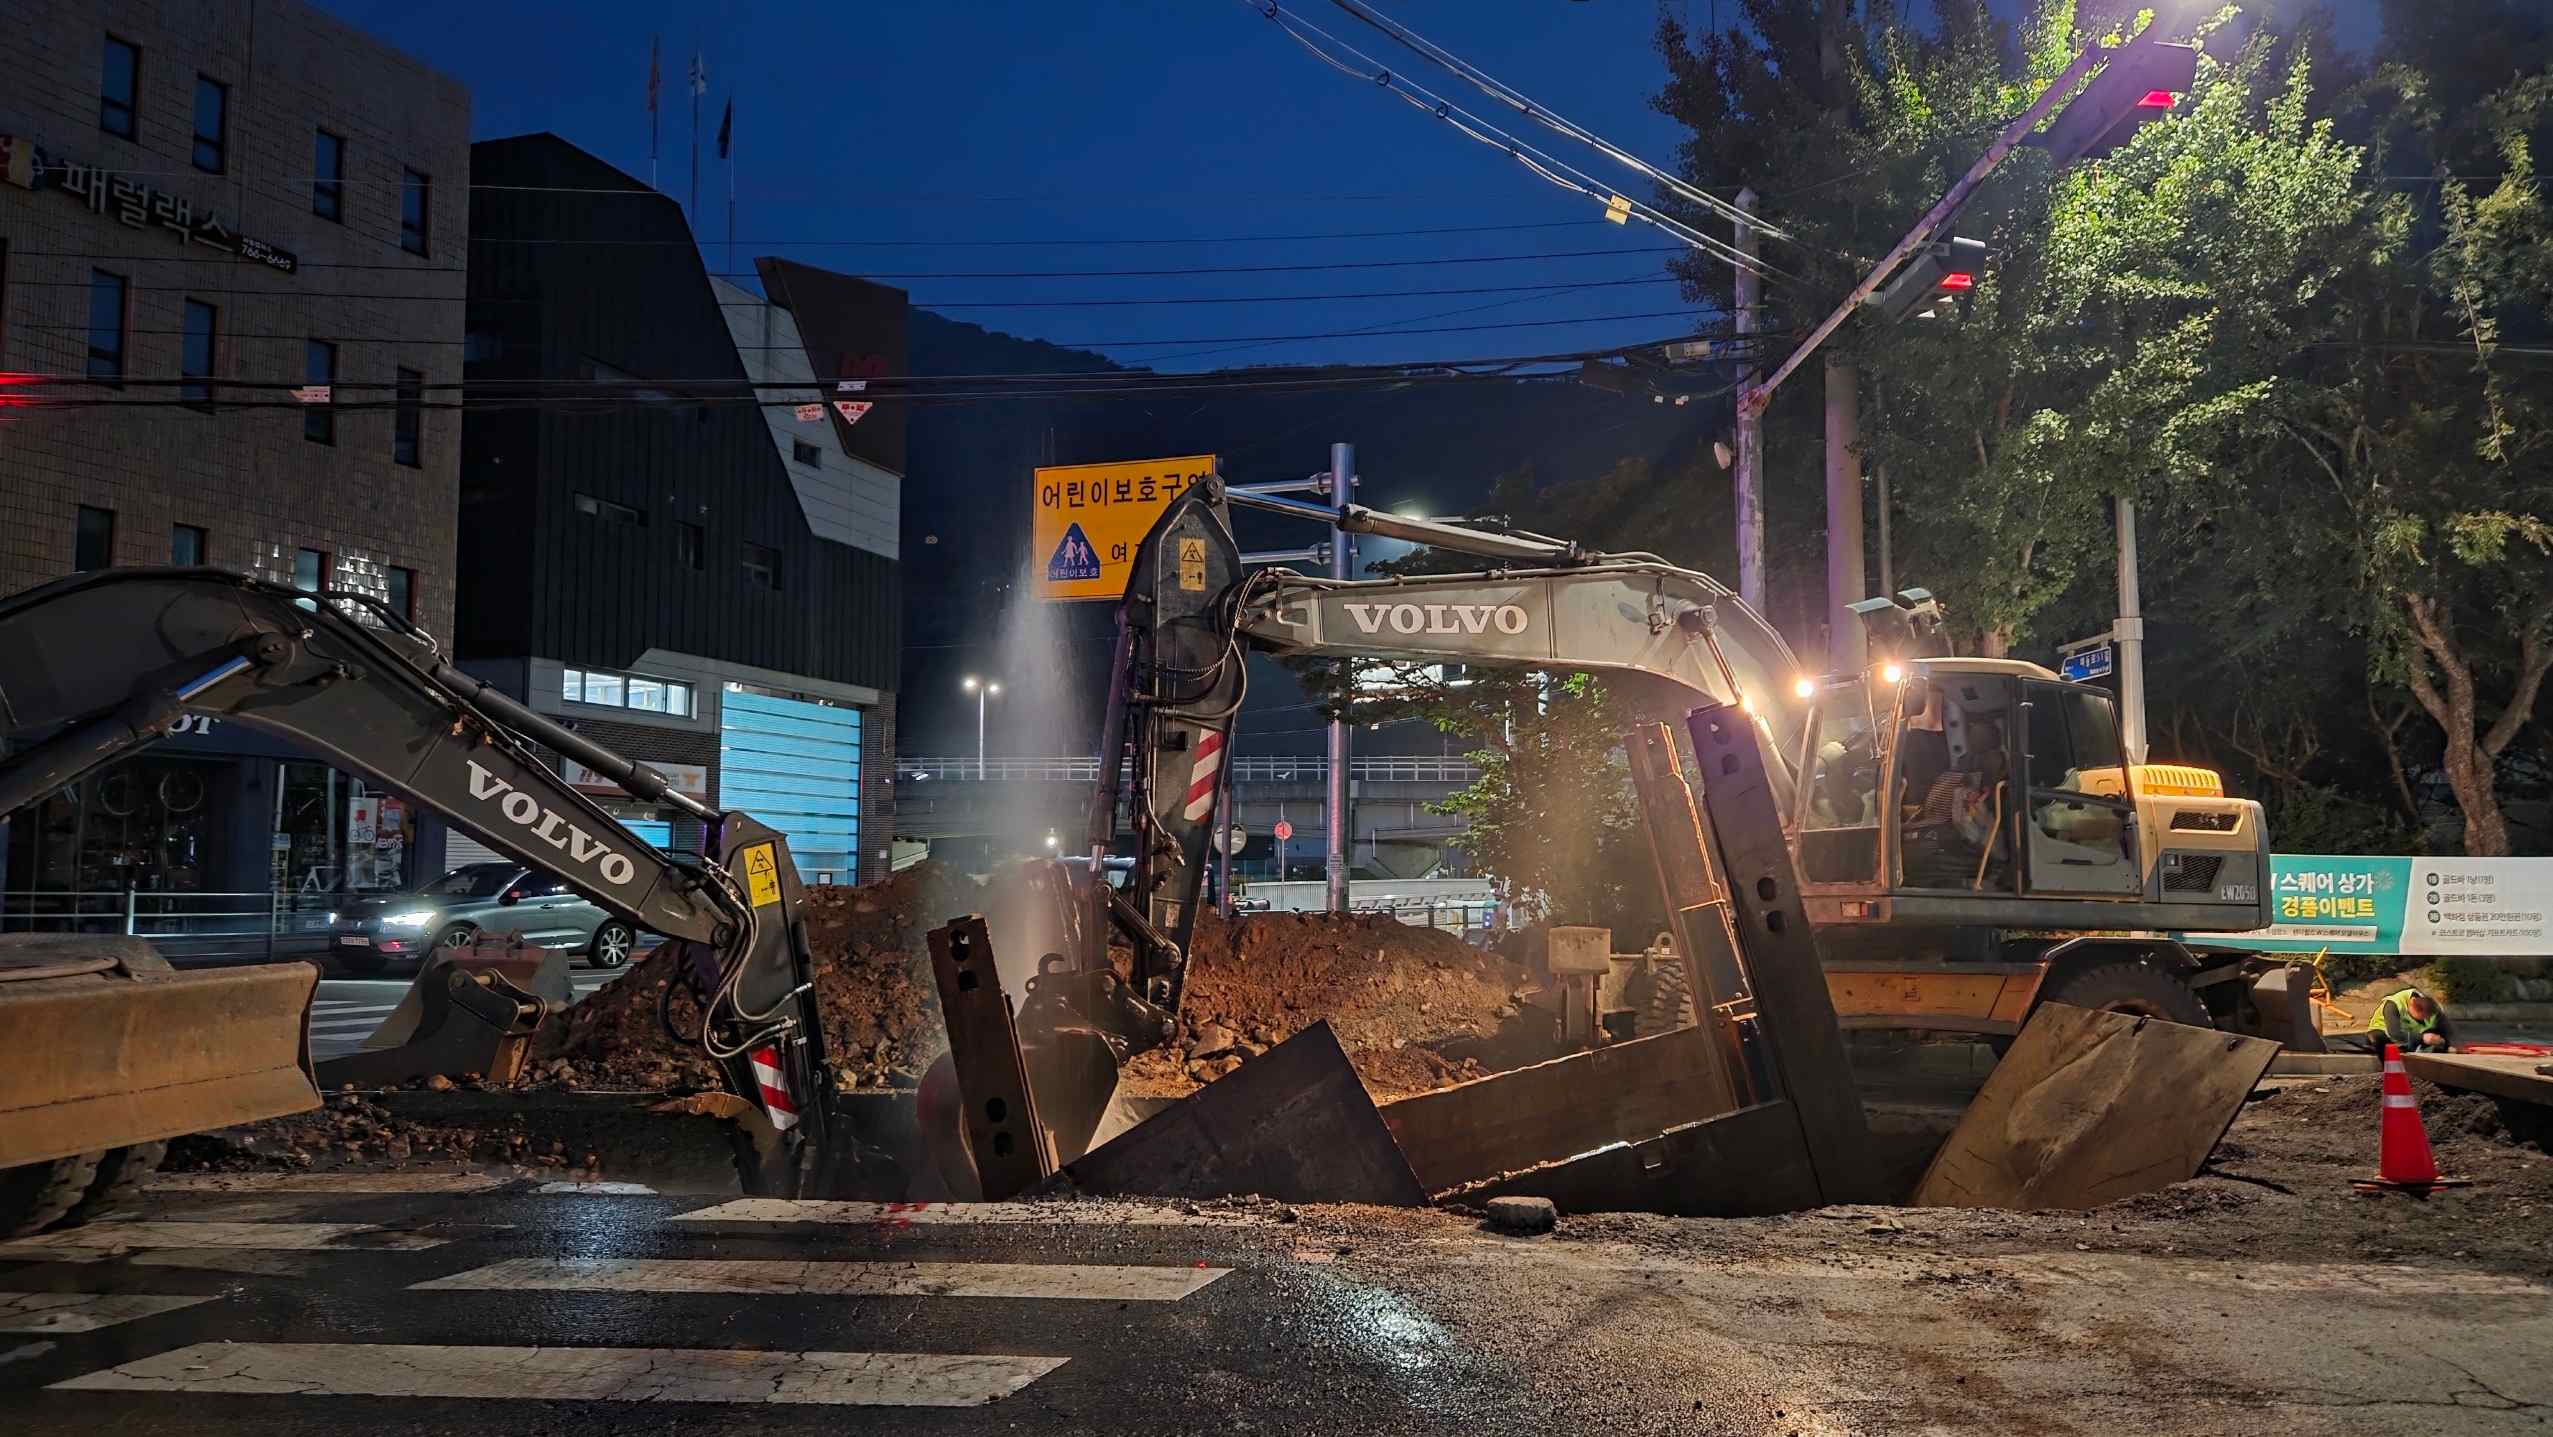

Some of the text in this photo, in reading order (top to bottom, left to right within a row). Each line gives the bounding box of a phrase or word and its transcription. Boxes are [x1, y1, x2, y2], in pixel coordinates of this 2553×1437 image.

[61, 160, 233, 253] 패럴랙스
[1343, 603, 1529, 635] VOLVO
[466, 759, 635, 885] VOLVO
[2279, 871, 2334, 894] 스퀘어
[2338, 872, 2375, 895] 상가
[2281, 896, 2376, 919] 경품이벤트
